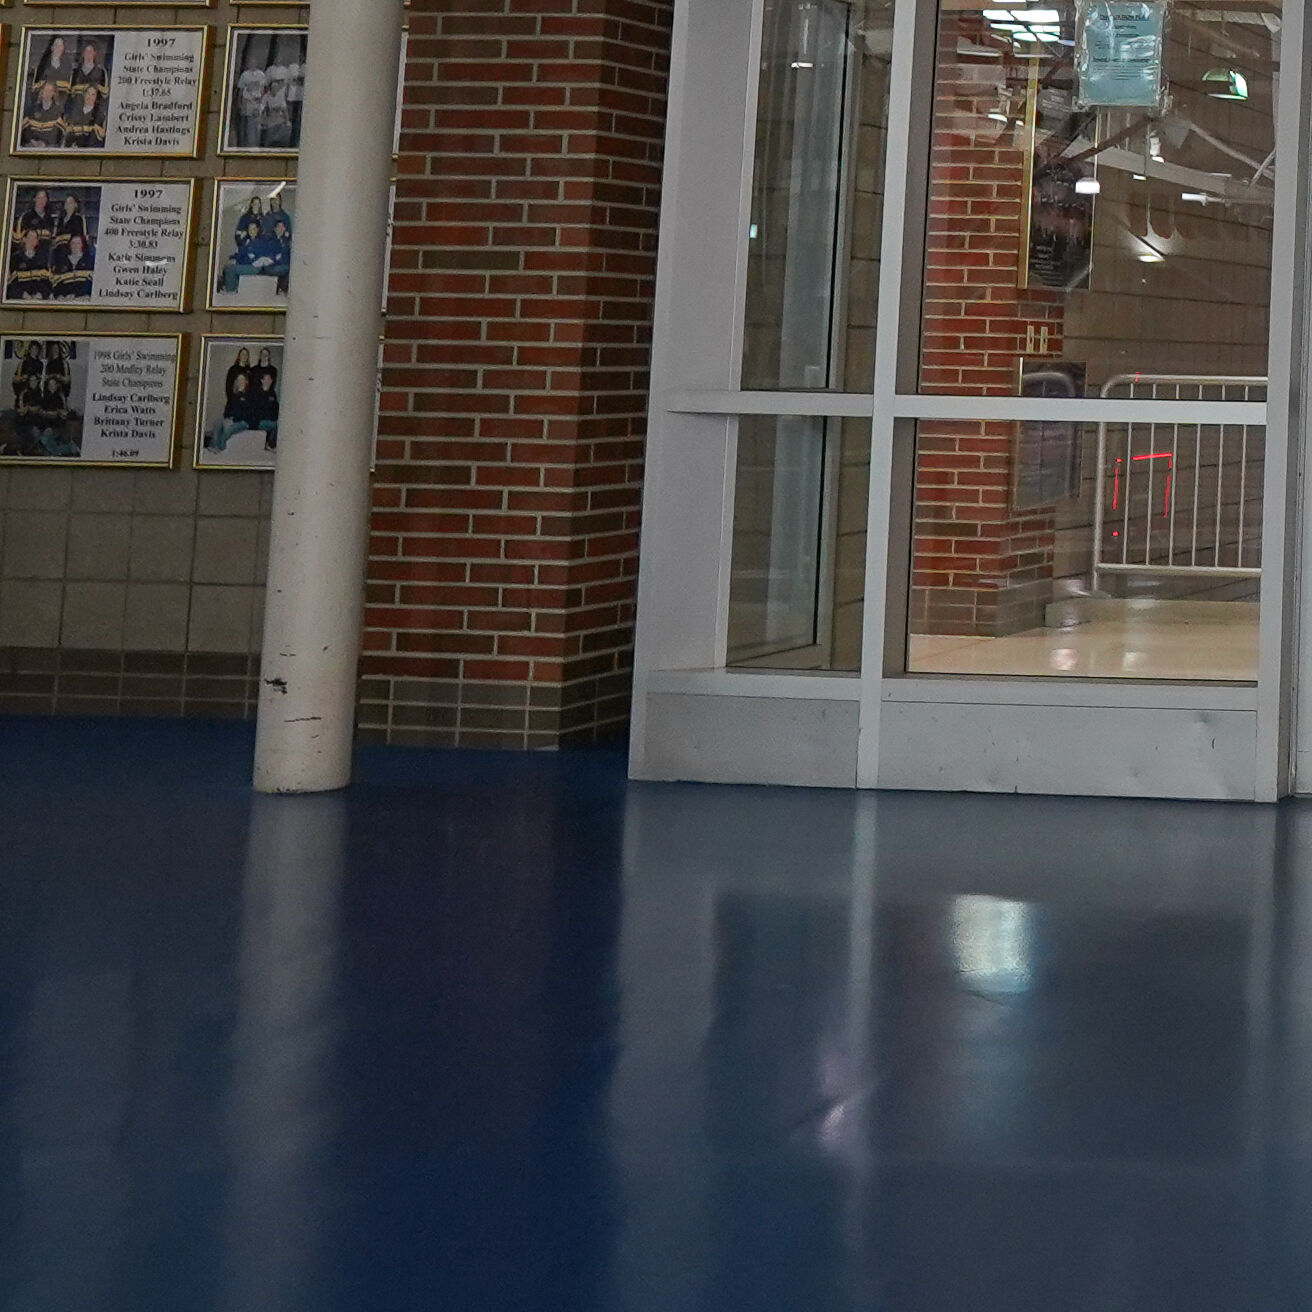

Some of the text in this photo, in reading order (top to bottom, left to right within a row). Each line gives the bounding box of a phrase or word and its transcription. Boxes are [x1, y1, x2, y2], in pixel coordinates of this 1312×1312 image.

[146, 38, 176, 47] 1997
[146, 64, 193, 75] Champions
[154, 136, 180, 146] Davis
[133, 189, 164, 199] 1997
[133, 215, 180, 227] Champions
